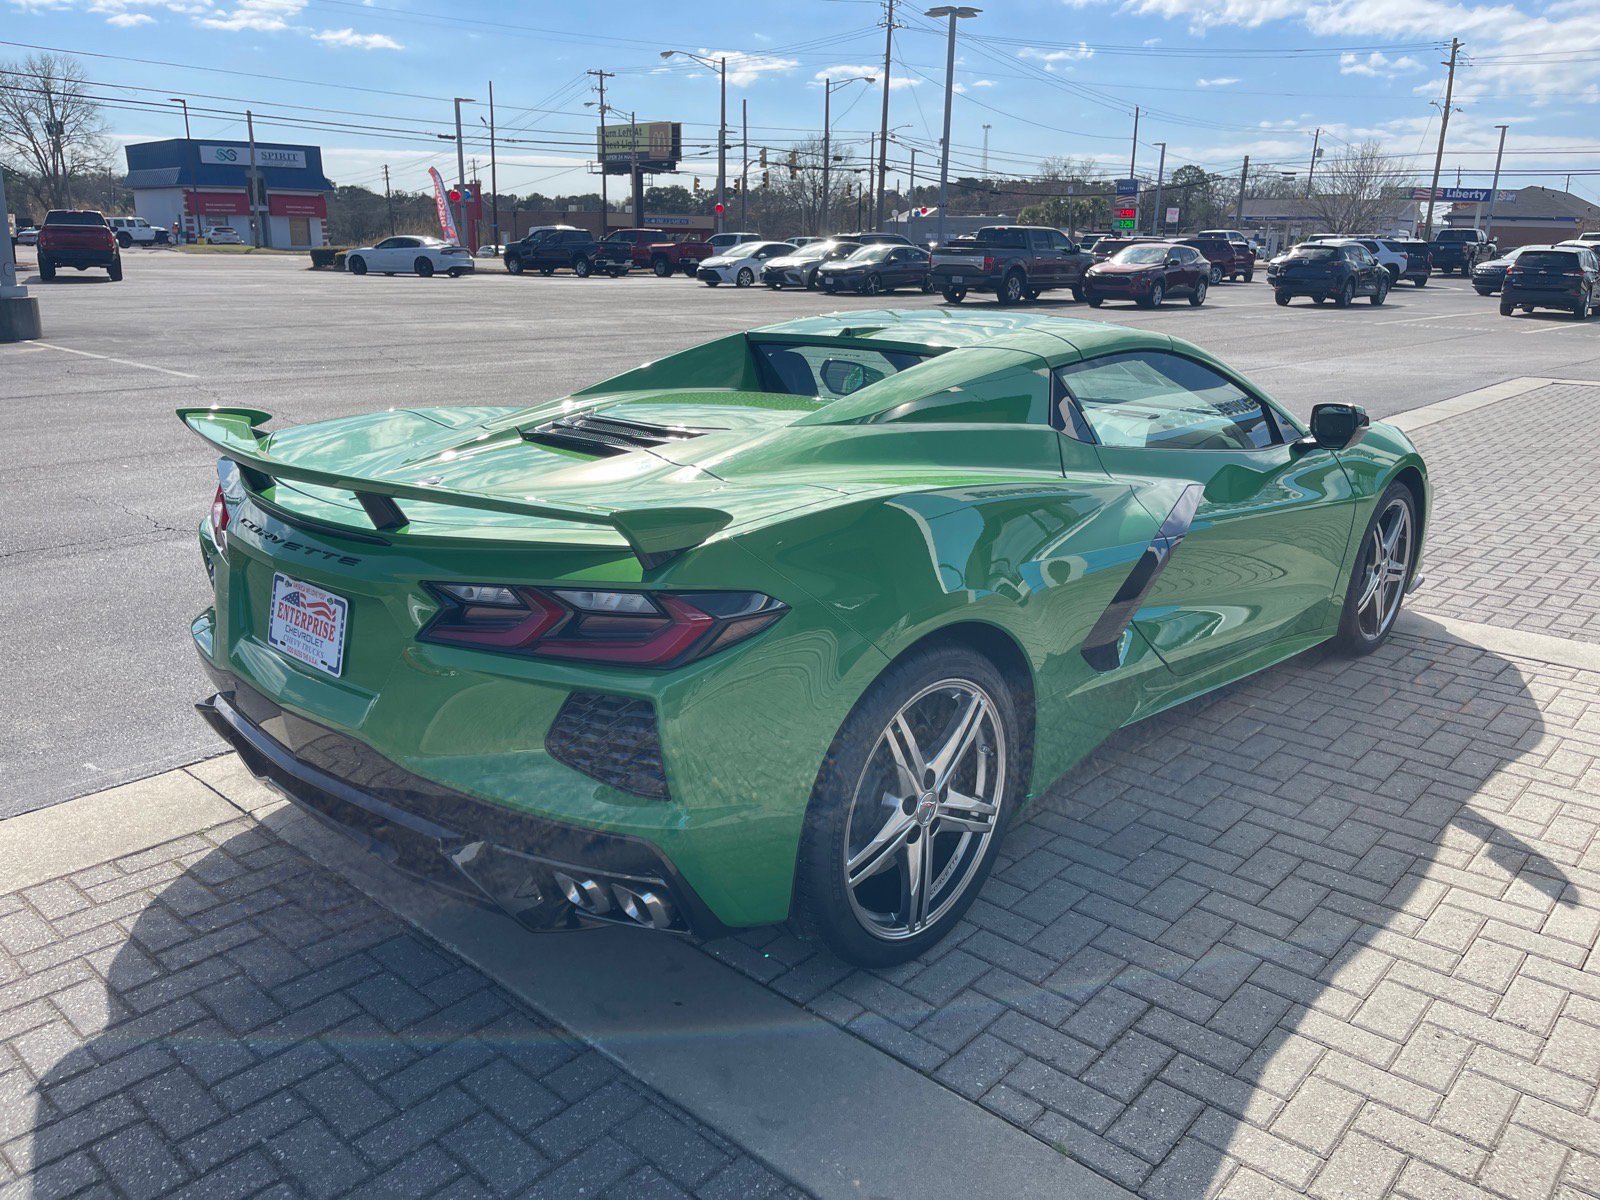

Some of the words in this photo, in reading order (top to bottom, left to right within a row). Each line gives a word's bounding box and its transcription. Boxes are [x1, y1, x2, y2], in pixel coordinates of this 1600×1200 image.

[619, 128, 632, 136] Left
[622, 140, 640, 150] Ligt
[261, 151, 298, 161] SPIRIT
[1446, 189, 1487, 200] Liberty
[240, 517, 363, 567] CORVETTE
[277, 602, 336, 642] ENTERPRISE
[285, 624, 324, 648] CHEVROLET
[283, 635, 302, 649] CHEVY
[302, 643, 325, 659] TRUCKS
